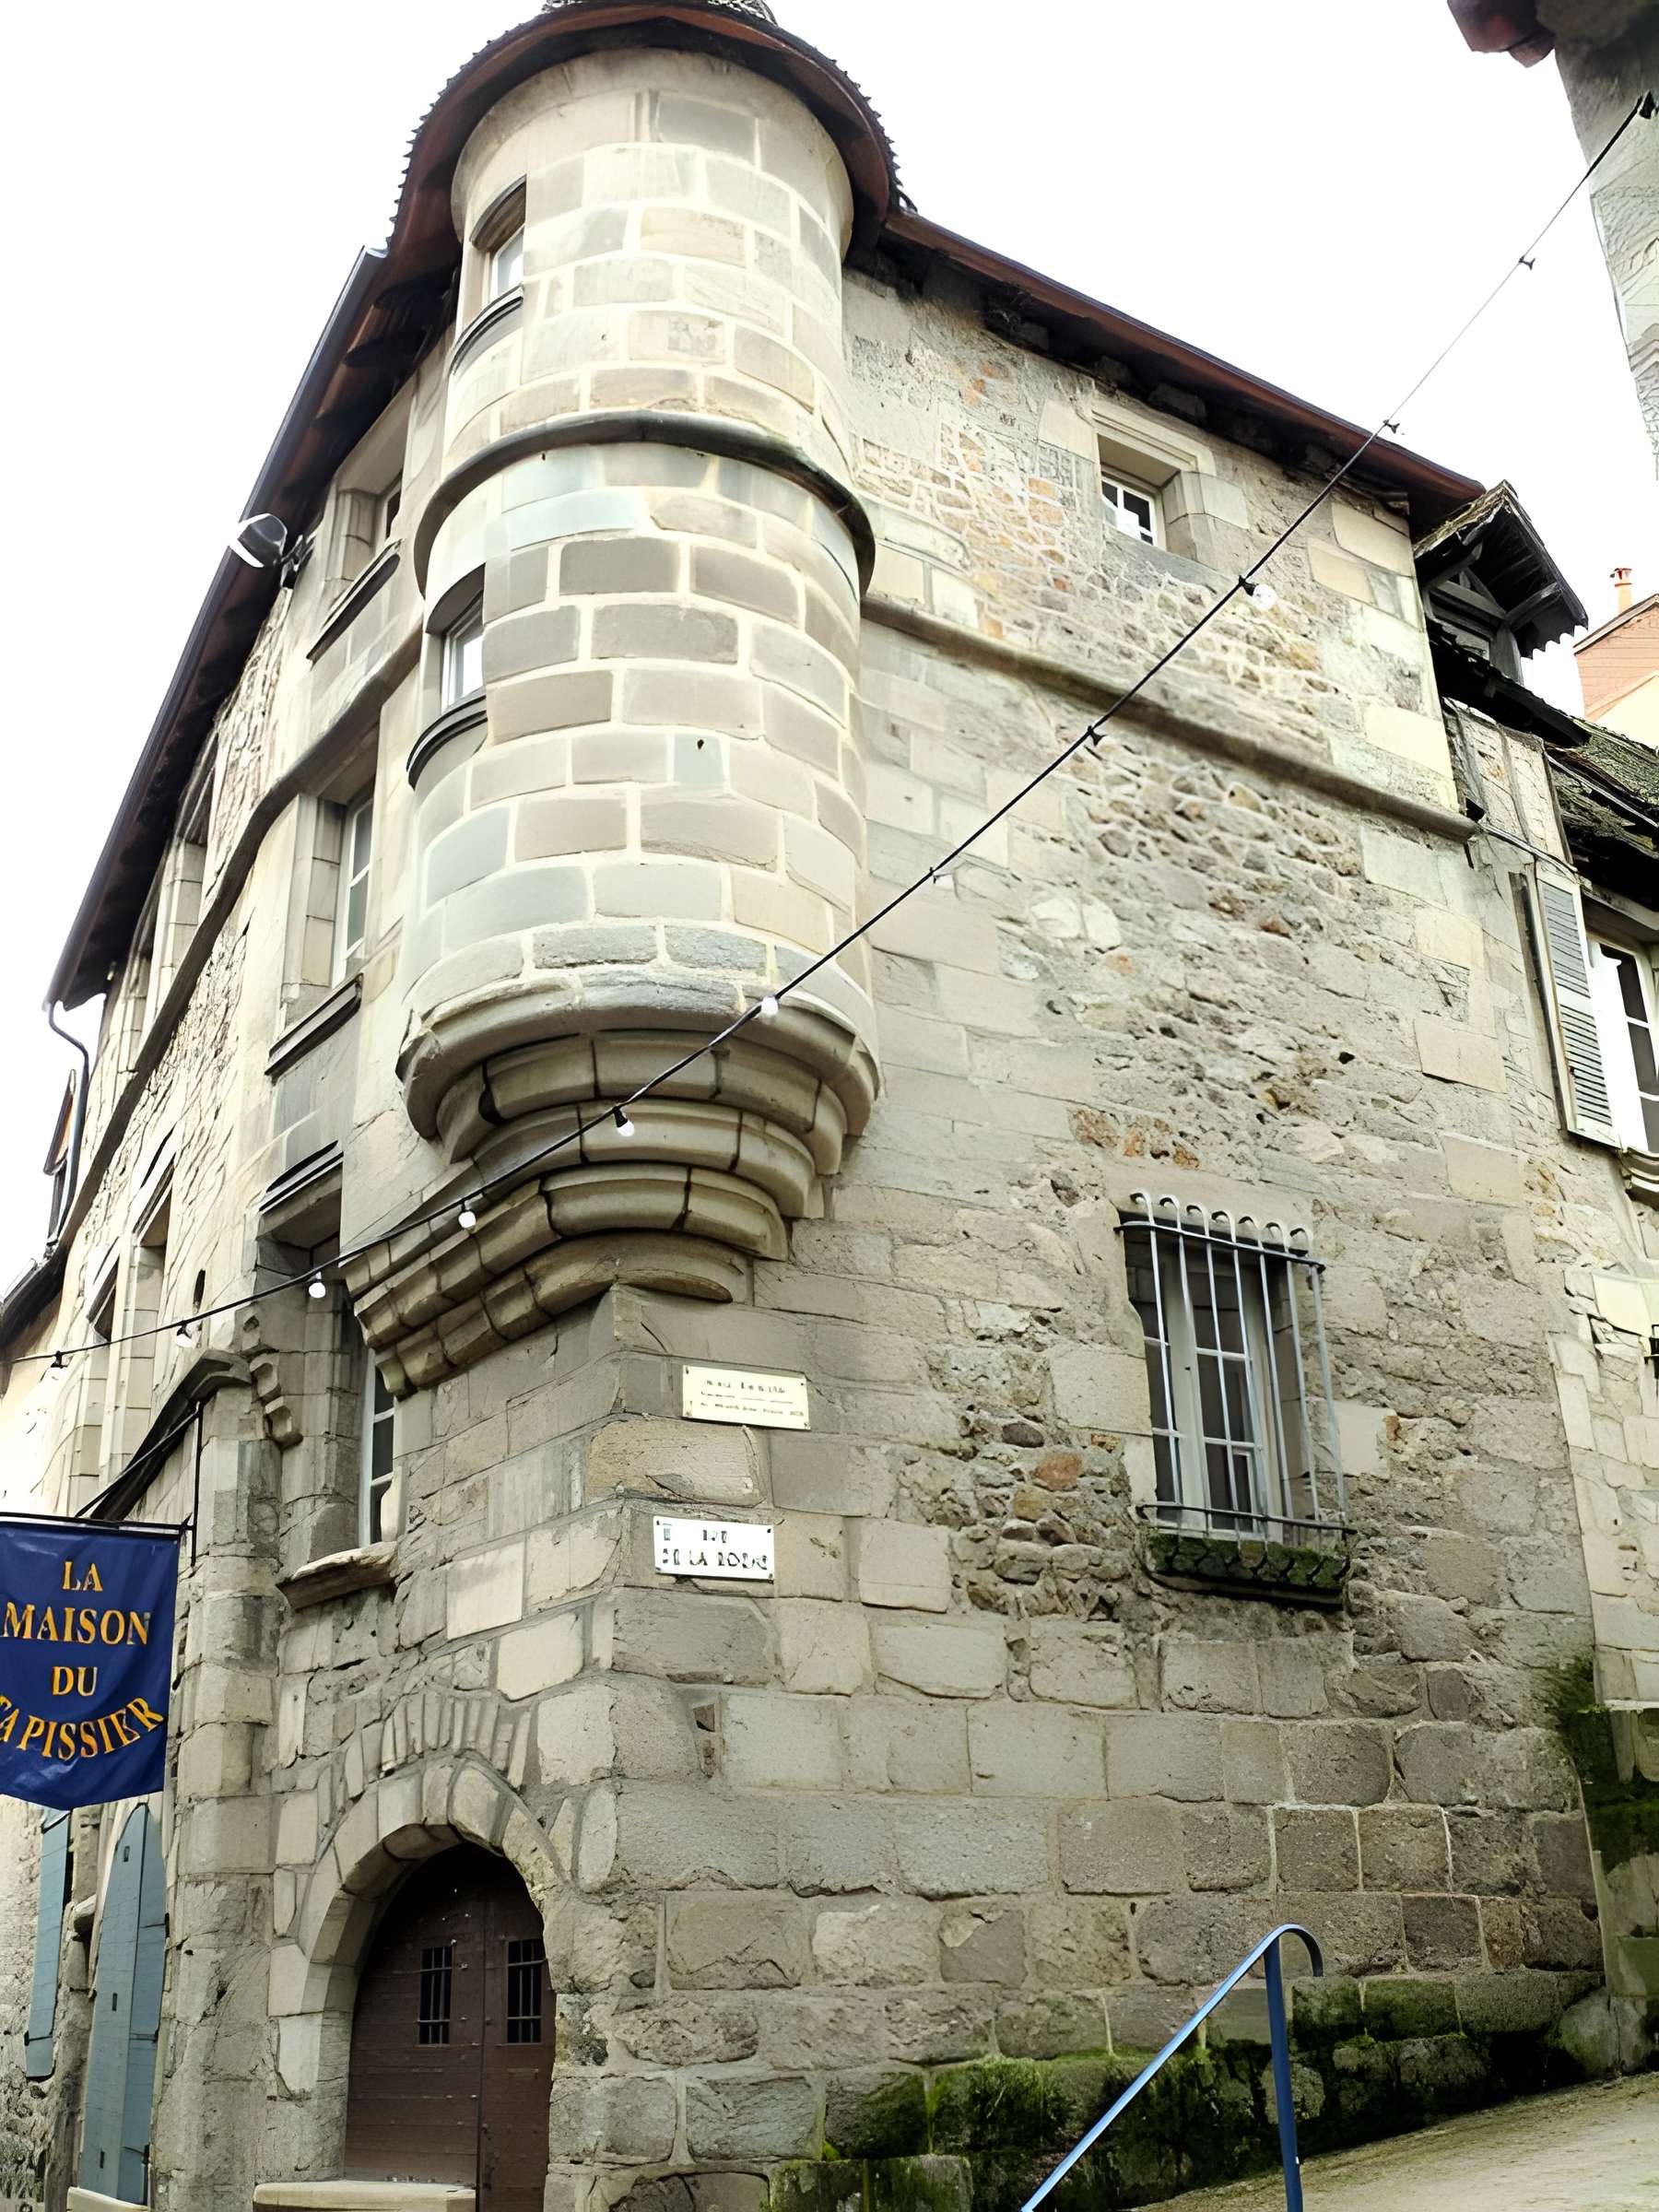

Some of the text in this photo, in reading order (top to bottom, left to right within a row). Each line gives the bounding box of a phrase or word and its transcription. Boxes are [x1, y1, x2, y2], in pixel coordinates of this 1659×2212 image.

[62, 1560, 103, 1592] LA
[2, 1602, 151, 1645] MAISON
[52, 1666, 98, 1696] DU
